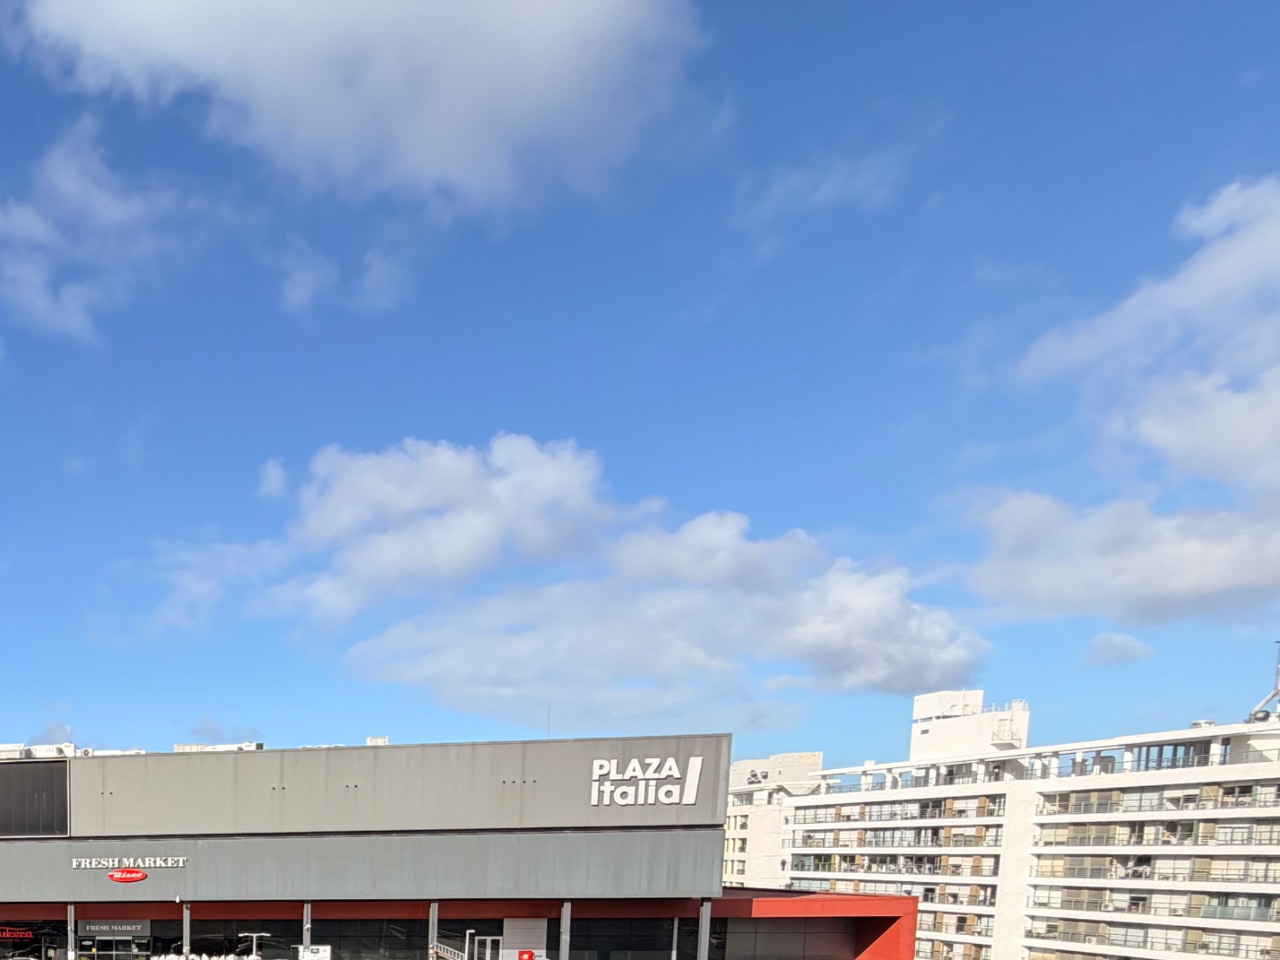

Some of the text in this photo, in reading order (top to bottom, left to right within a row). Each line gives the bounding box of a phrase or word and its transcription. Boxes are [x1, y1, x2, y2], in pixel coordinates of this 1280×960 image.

[592, 757, 681, 781] PLAZA
[590, 780, 681, 806] Italia
[71, 856, 188, 869] FRESH MARKET
